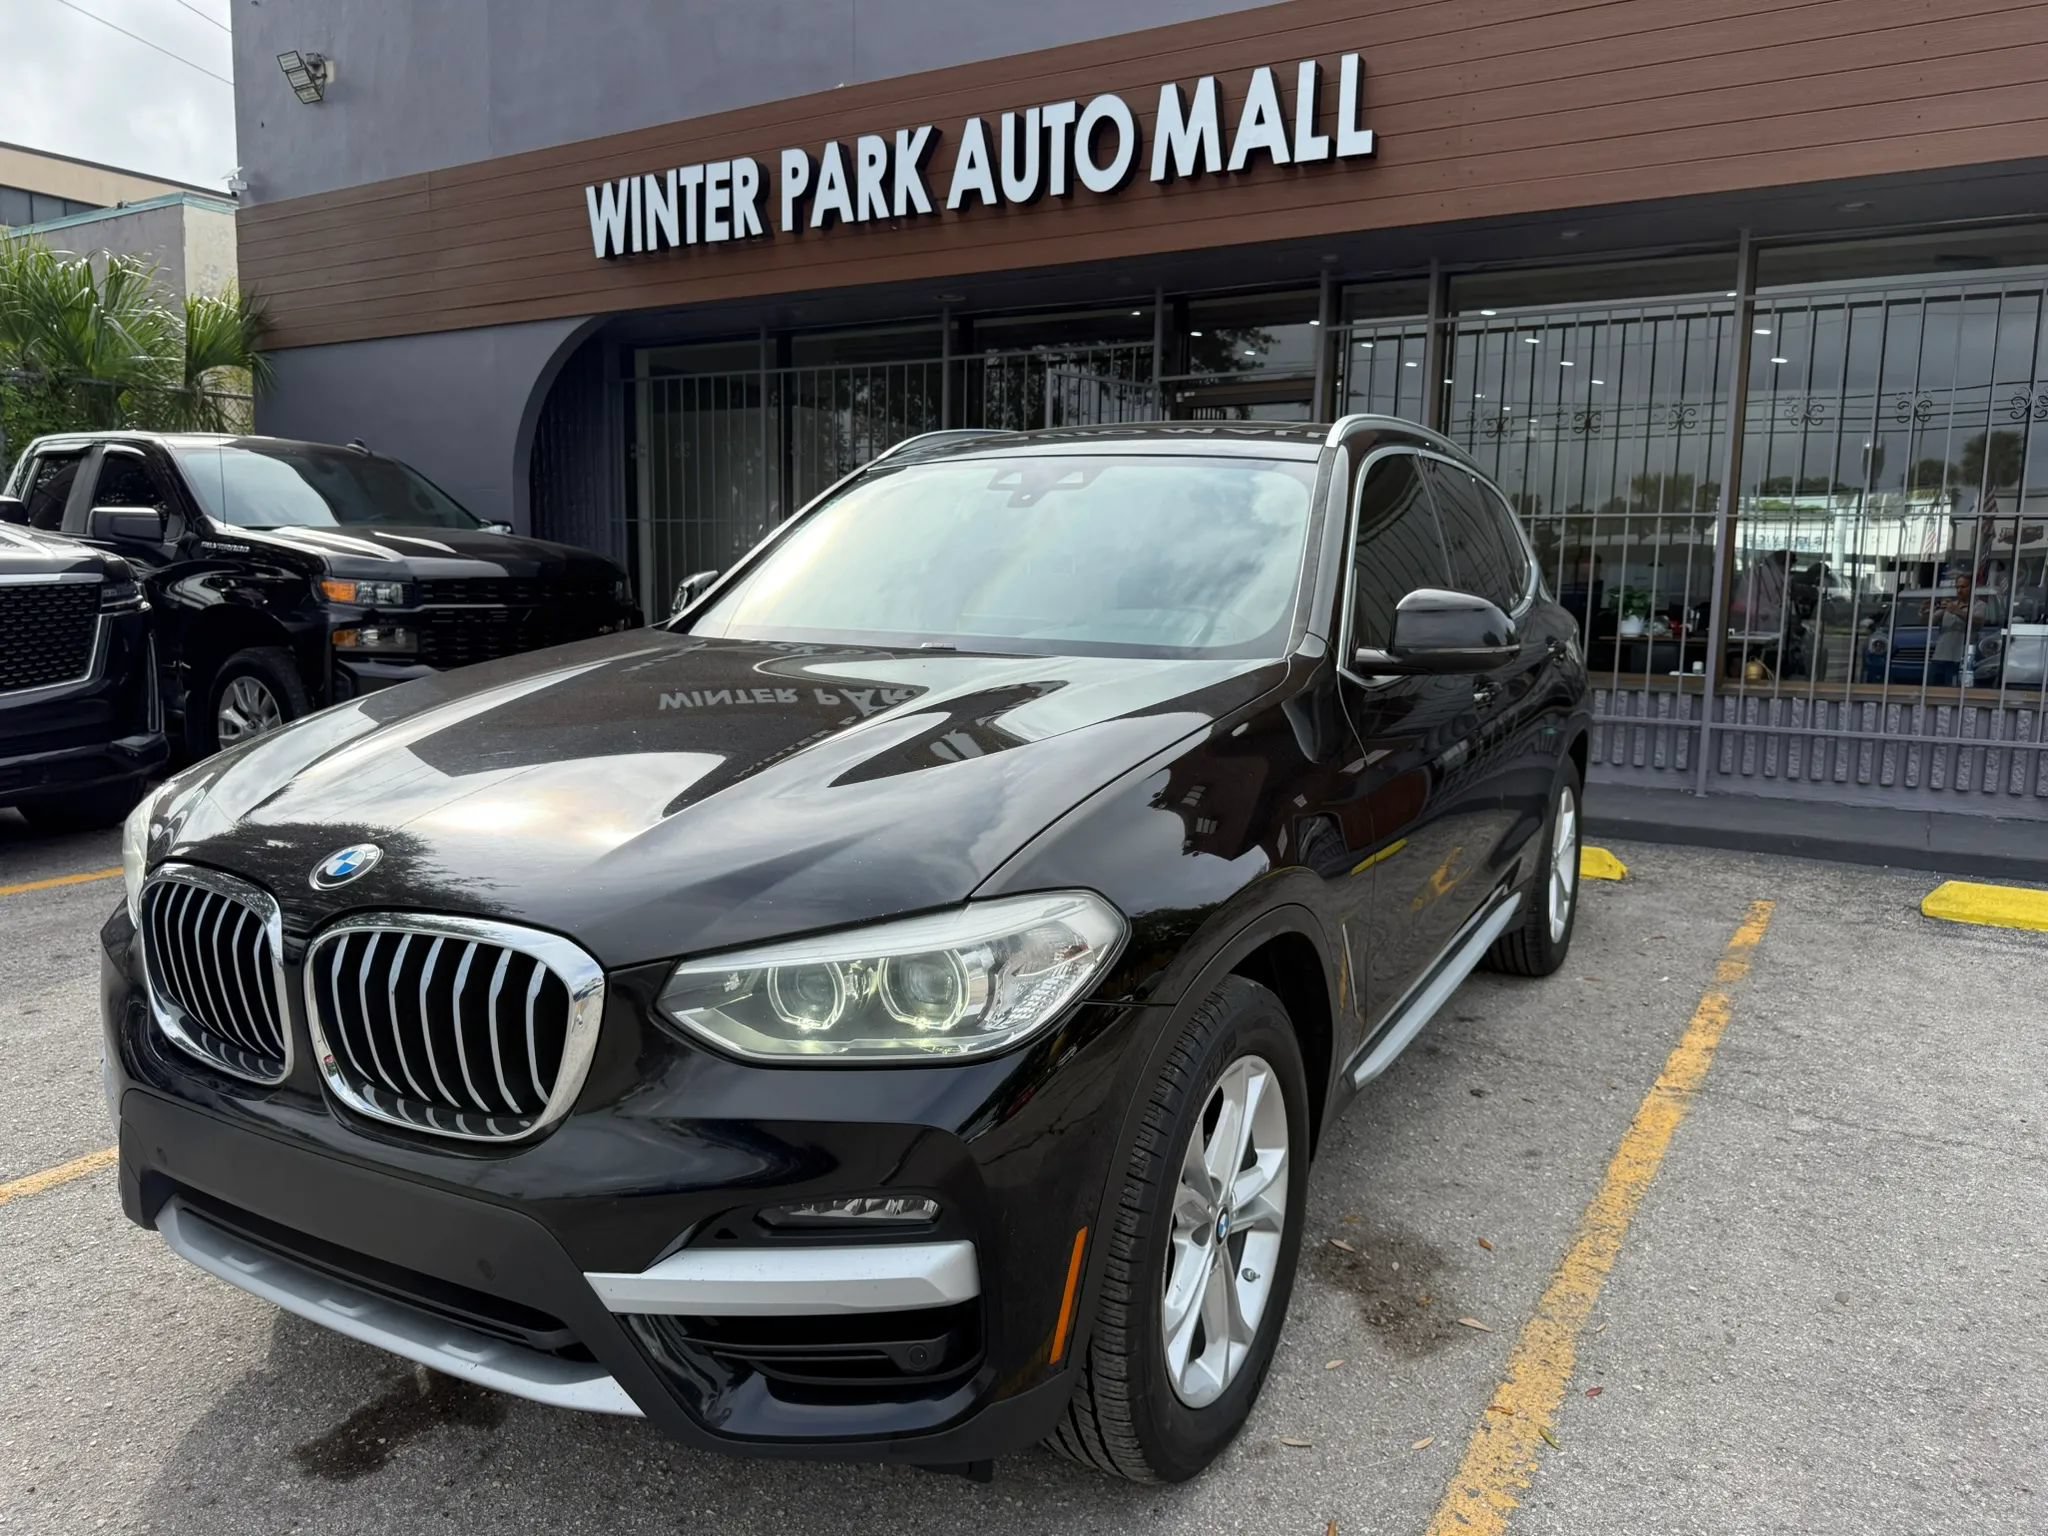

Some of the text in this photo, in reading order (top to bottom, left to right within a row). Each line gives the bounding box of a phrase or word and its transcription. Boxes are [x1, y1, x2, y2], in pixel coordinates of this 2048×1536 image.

[585, 53, 1375, 259] WINTER PARK AUTO MALL
